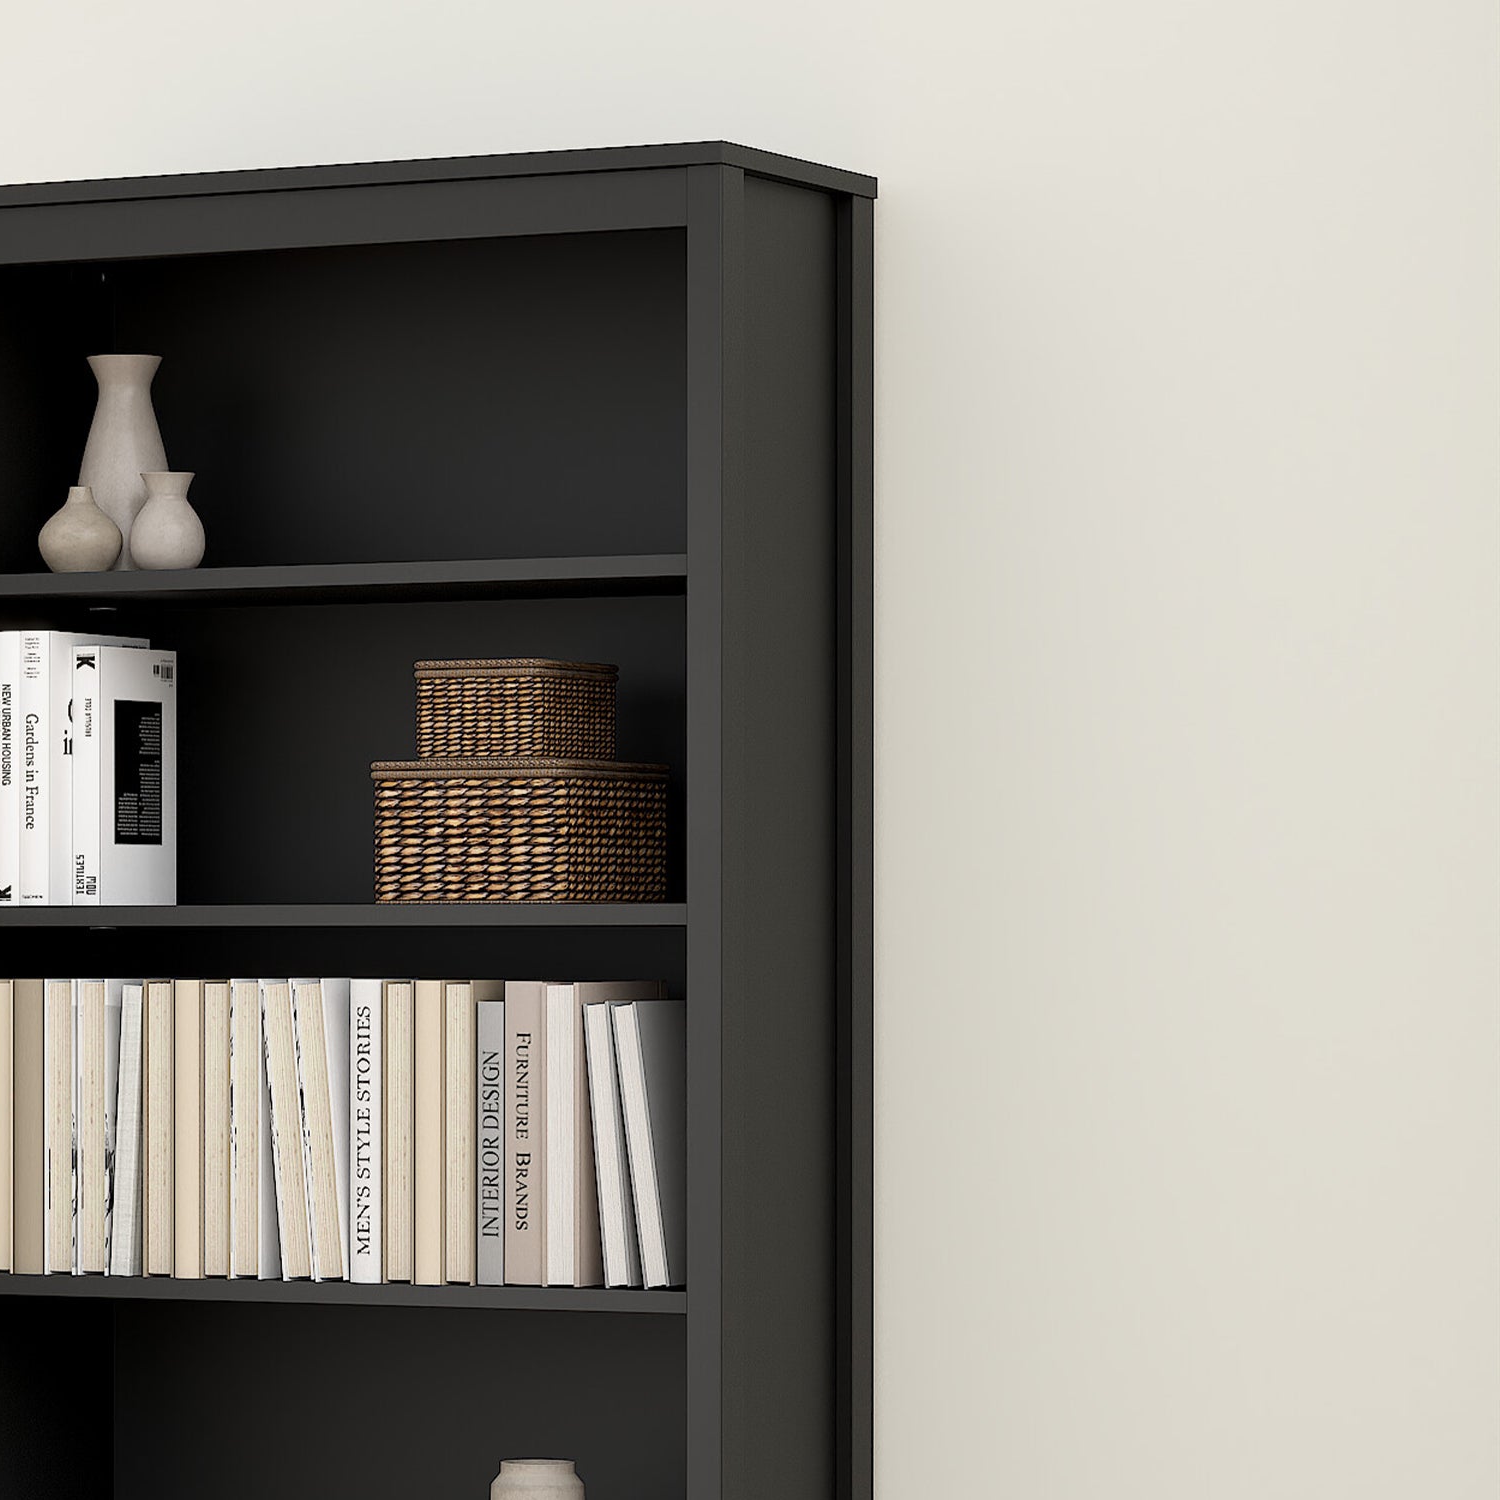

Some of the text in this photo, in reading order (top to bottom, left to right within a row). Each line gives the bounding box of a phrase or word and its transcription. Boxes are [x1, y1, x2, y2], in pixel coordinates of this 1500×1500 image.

[2, 684, 12, 786] NEW URBAN HOUSING
[25, 713, 39, 830] Gardens in France
[76, 854, 85, 895] TEXTILES
[357, 1005, 371, 1255] MEN'S STYLE STORIES
[482, 1051, 500, 1238] INTERIOR DESIGN
